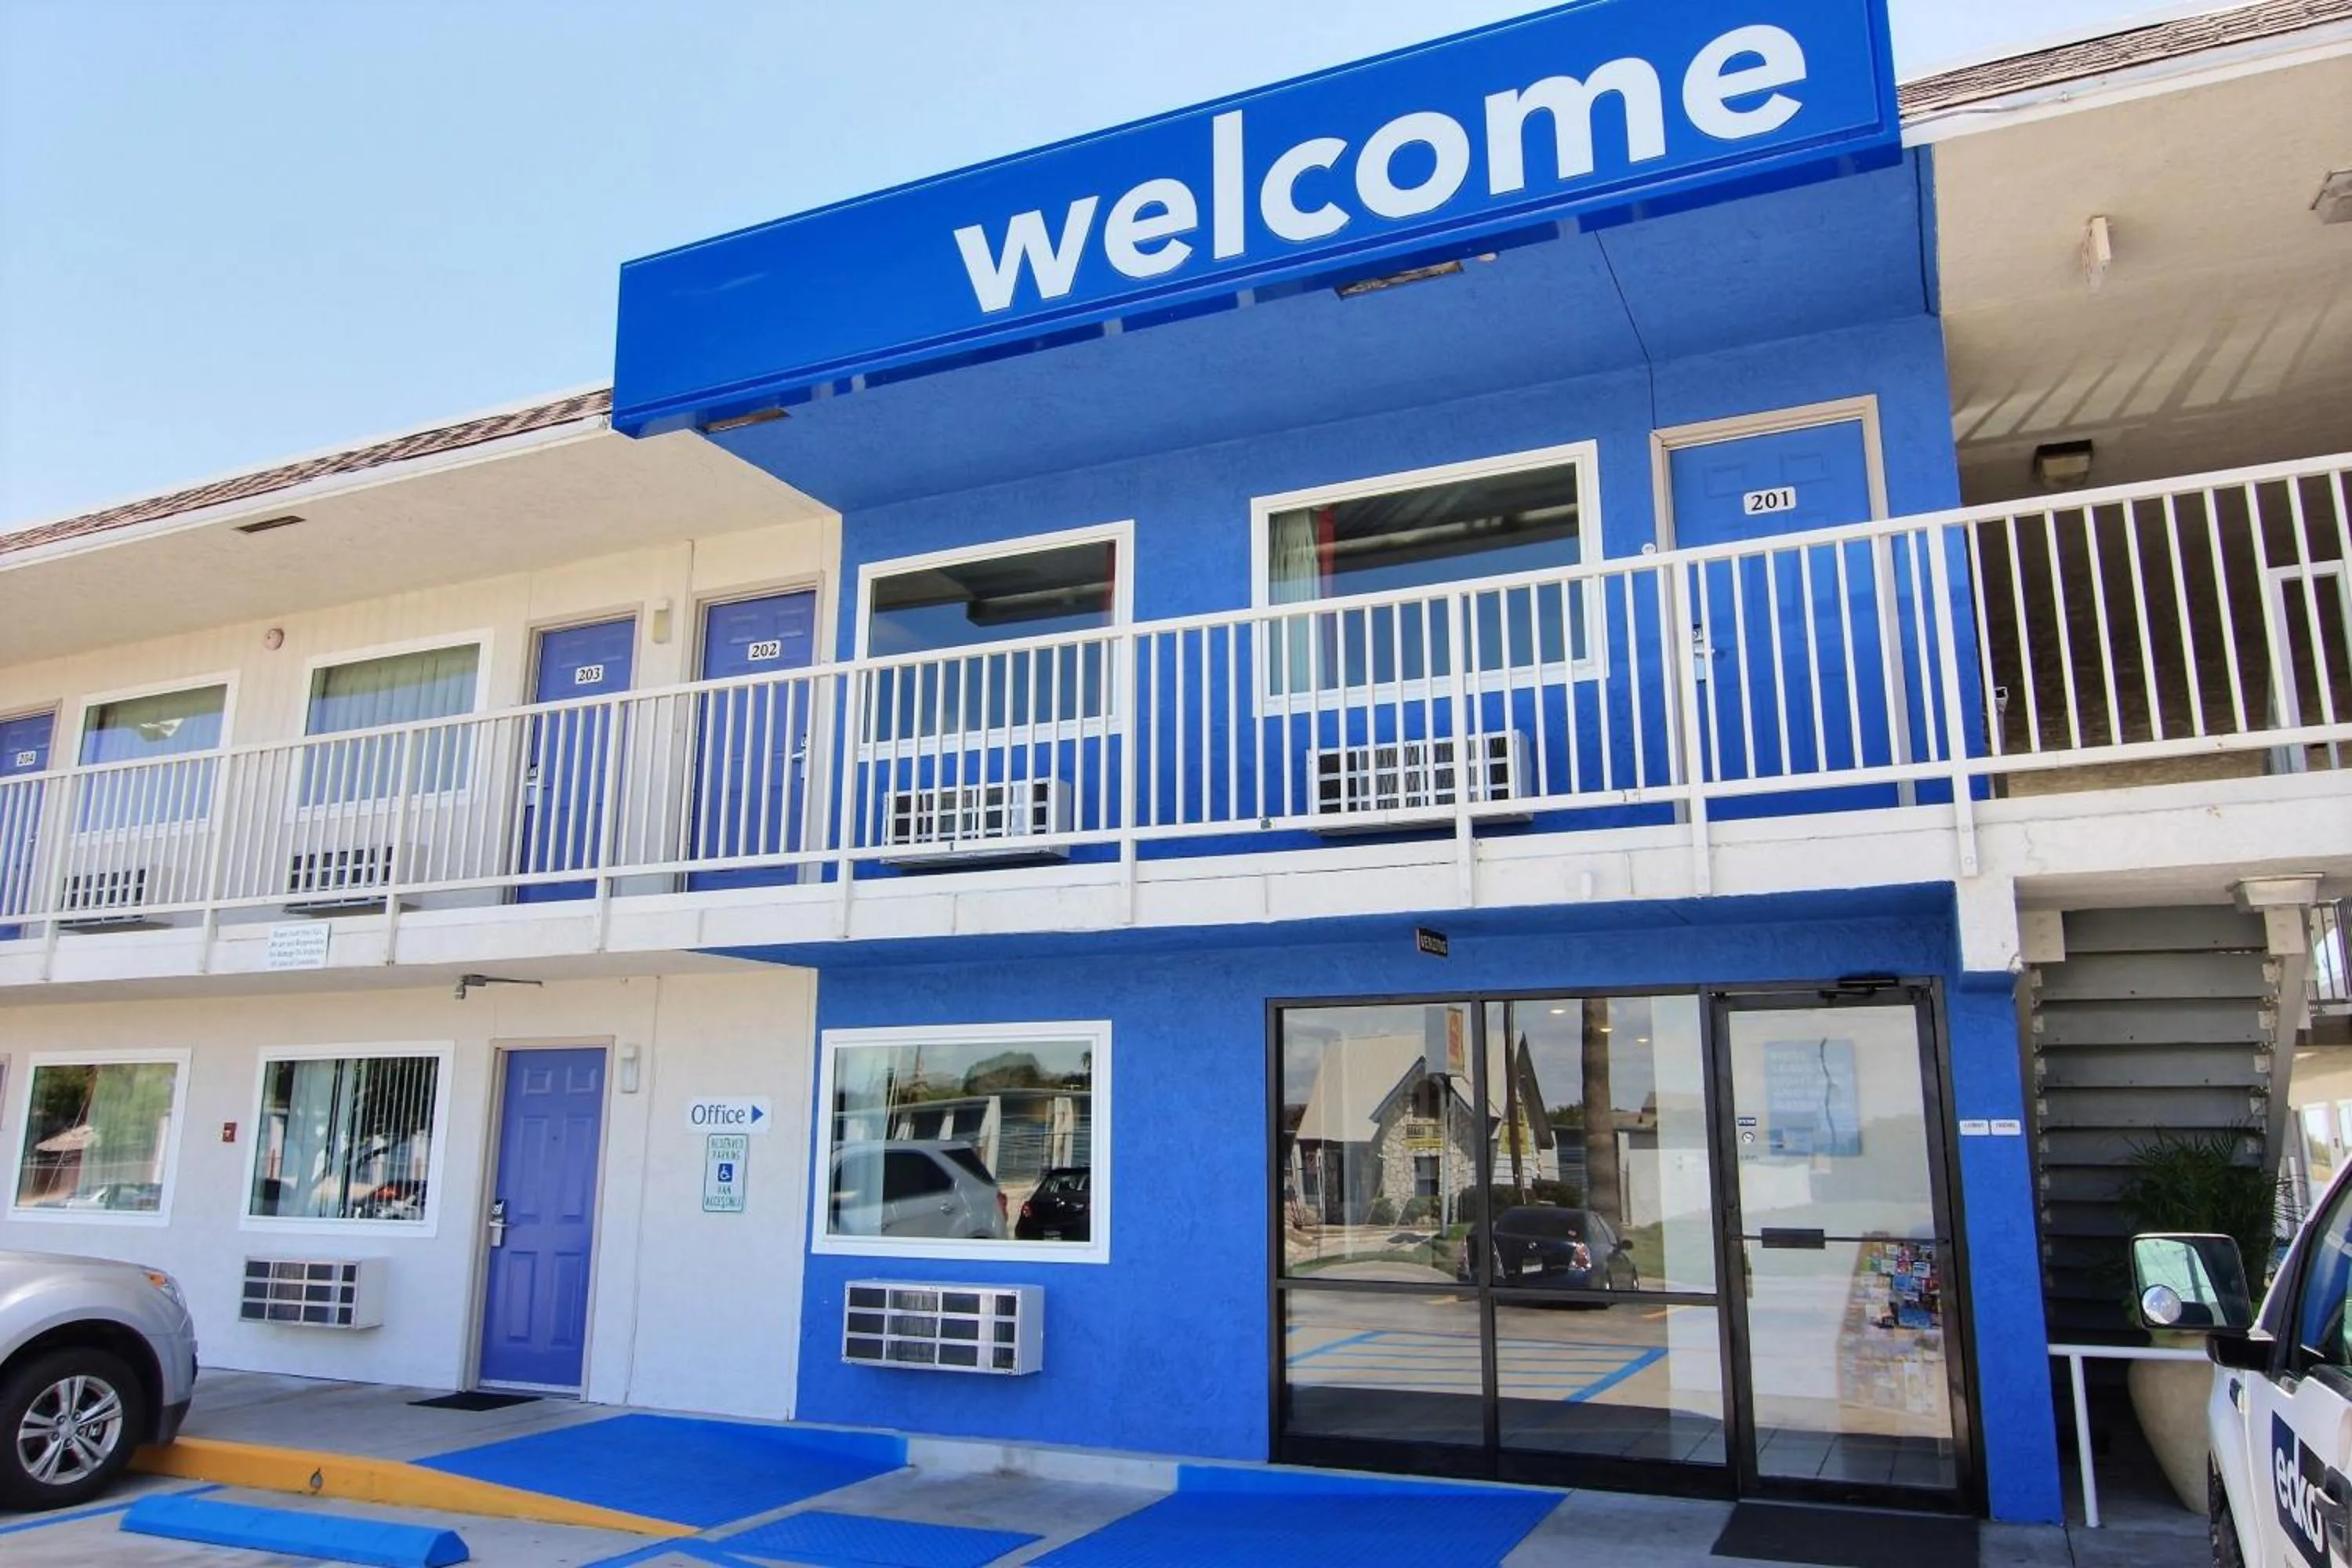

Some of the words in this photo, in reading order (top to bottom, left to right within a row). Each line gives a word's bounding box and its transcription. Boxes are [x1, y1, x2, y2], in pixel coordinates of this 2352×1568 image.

[953, 24, 1807, 314] welcome
[1751, 490, 1788, 511] 201
[752, 642, 777, 658] 202
[578, 667, 600, 681] 203
[691, 1104, 746, 1125] Office
